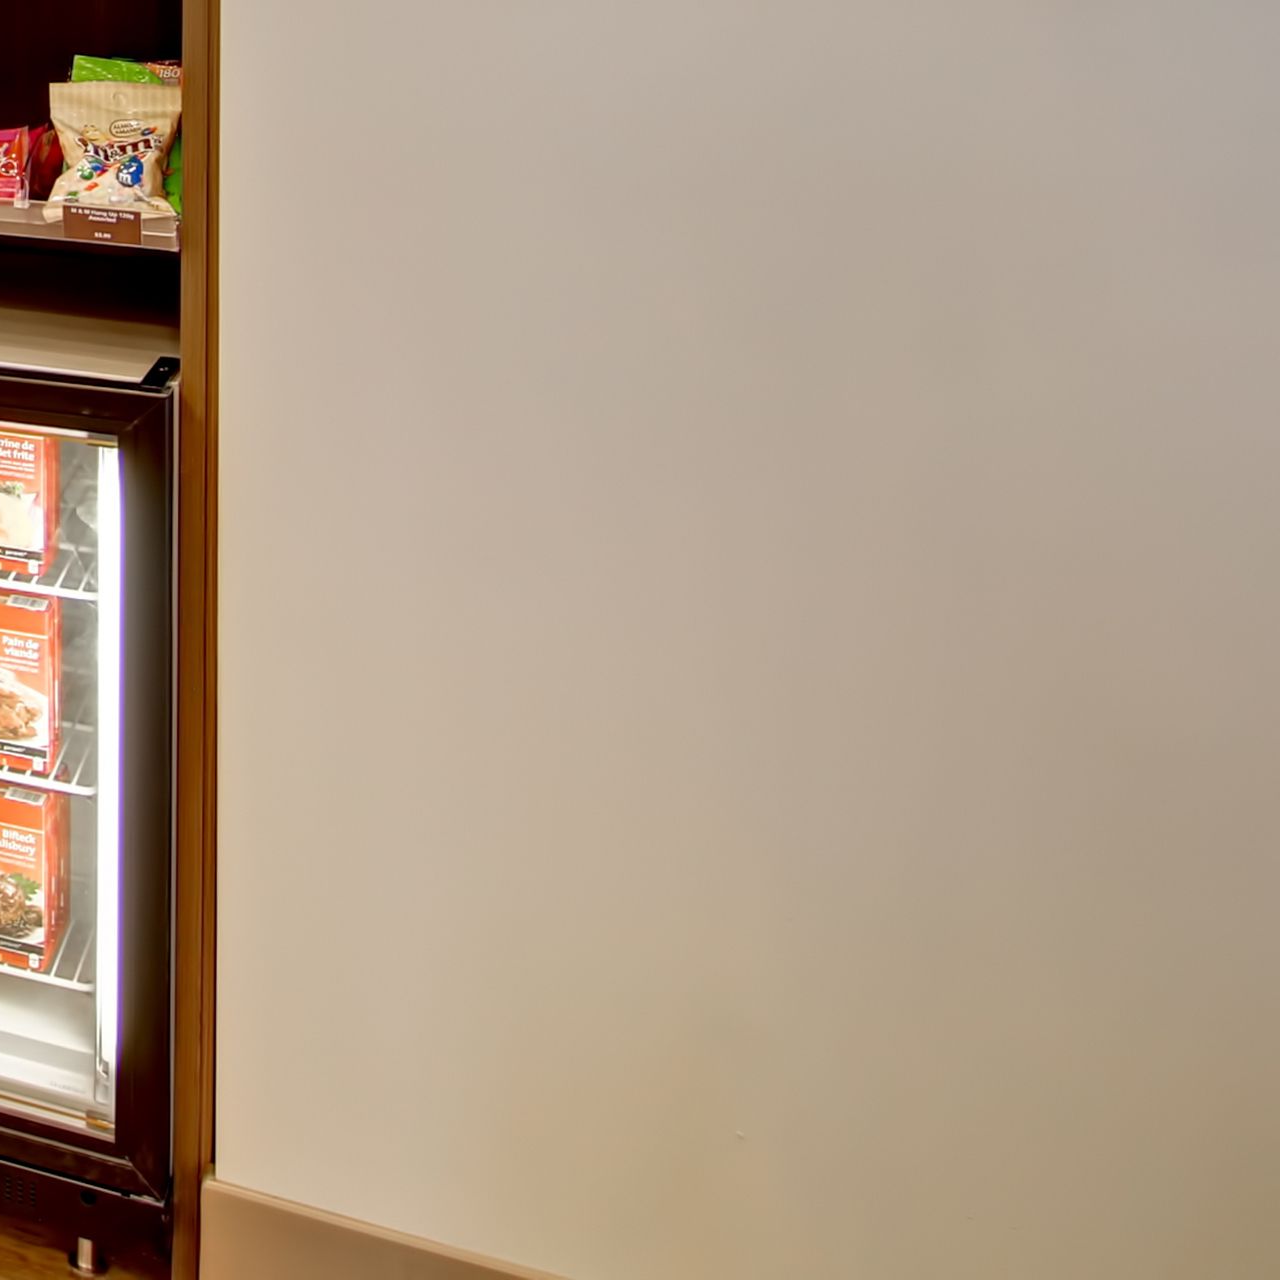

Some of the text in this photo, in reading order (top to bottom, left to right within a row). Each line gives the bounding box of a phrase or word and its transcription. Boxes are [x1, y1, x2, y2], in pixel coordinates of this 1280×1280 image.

[160, 70, 179, 78] 180
[22, 442, 35, 451] de
[13, 449, 35, 461] frite
[1, 634, 39, 648] Pain de
[2, 829, 36, 844] Bifteck
